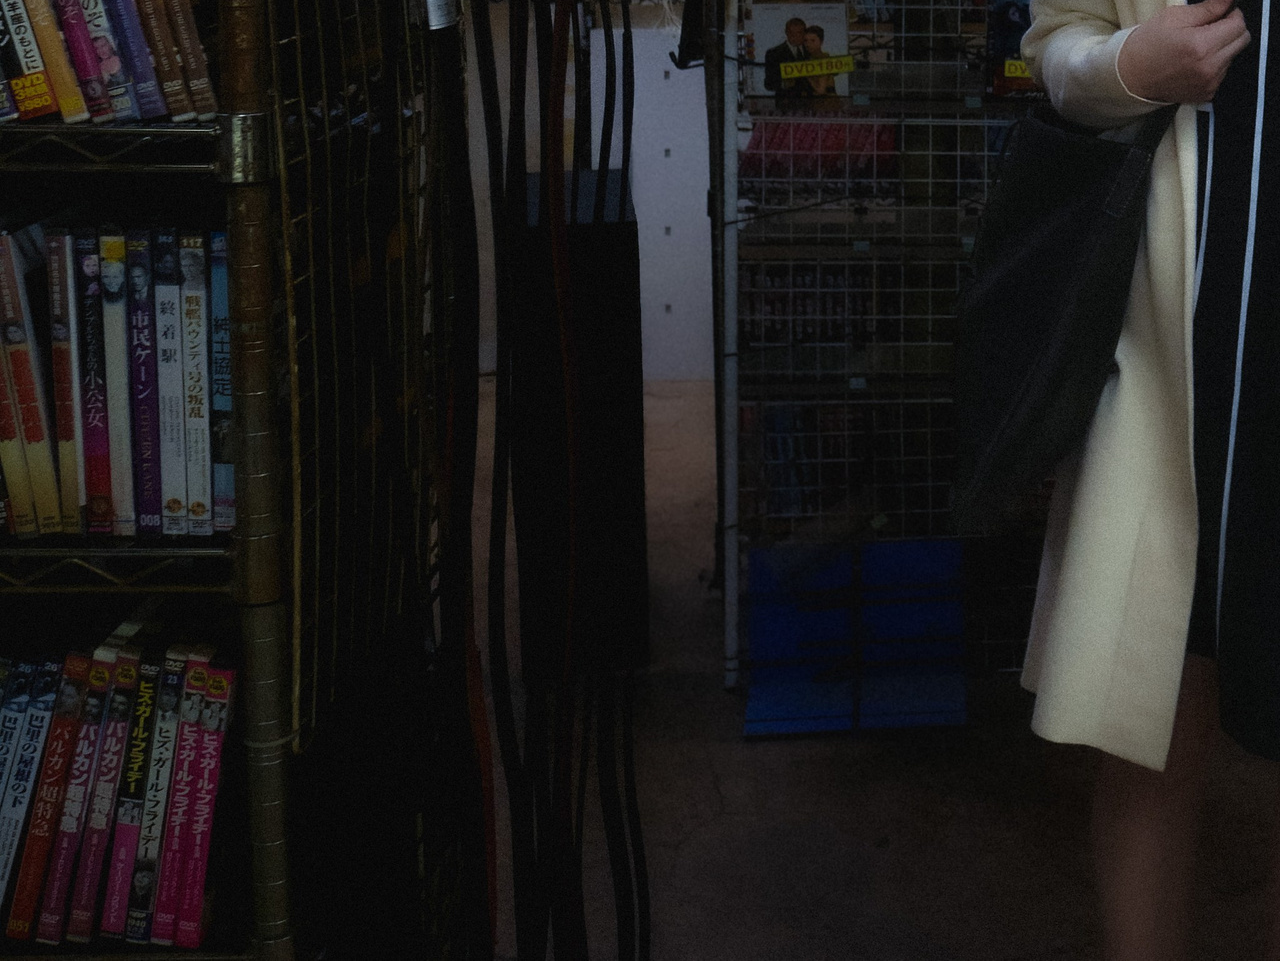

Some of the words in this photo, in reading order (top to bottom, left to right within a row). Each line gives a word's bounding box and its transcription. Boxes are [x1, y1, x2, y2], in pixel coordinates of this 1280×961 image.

[11, 72, 45, 90] DVD
[131, 311, 153, 399] 市民ケーン
[159, 300, 178, 364] 終着駅
[11, 713, 46, 808] 巴里の屋根の下
[31, 725, 71, 837] バルカン超特急
[59, 723, 99, 834] バルカン超特急
[87, 719, 126, 830] バルカン超特急
[125, 679, 156, 793] ヒズ・ガール・フライデー
[138, 726, 173, 860] ヒズ・ガール・フライデー
